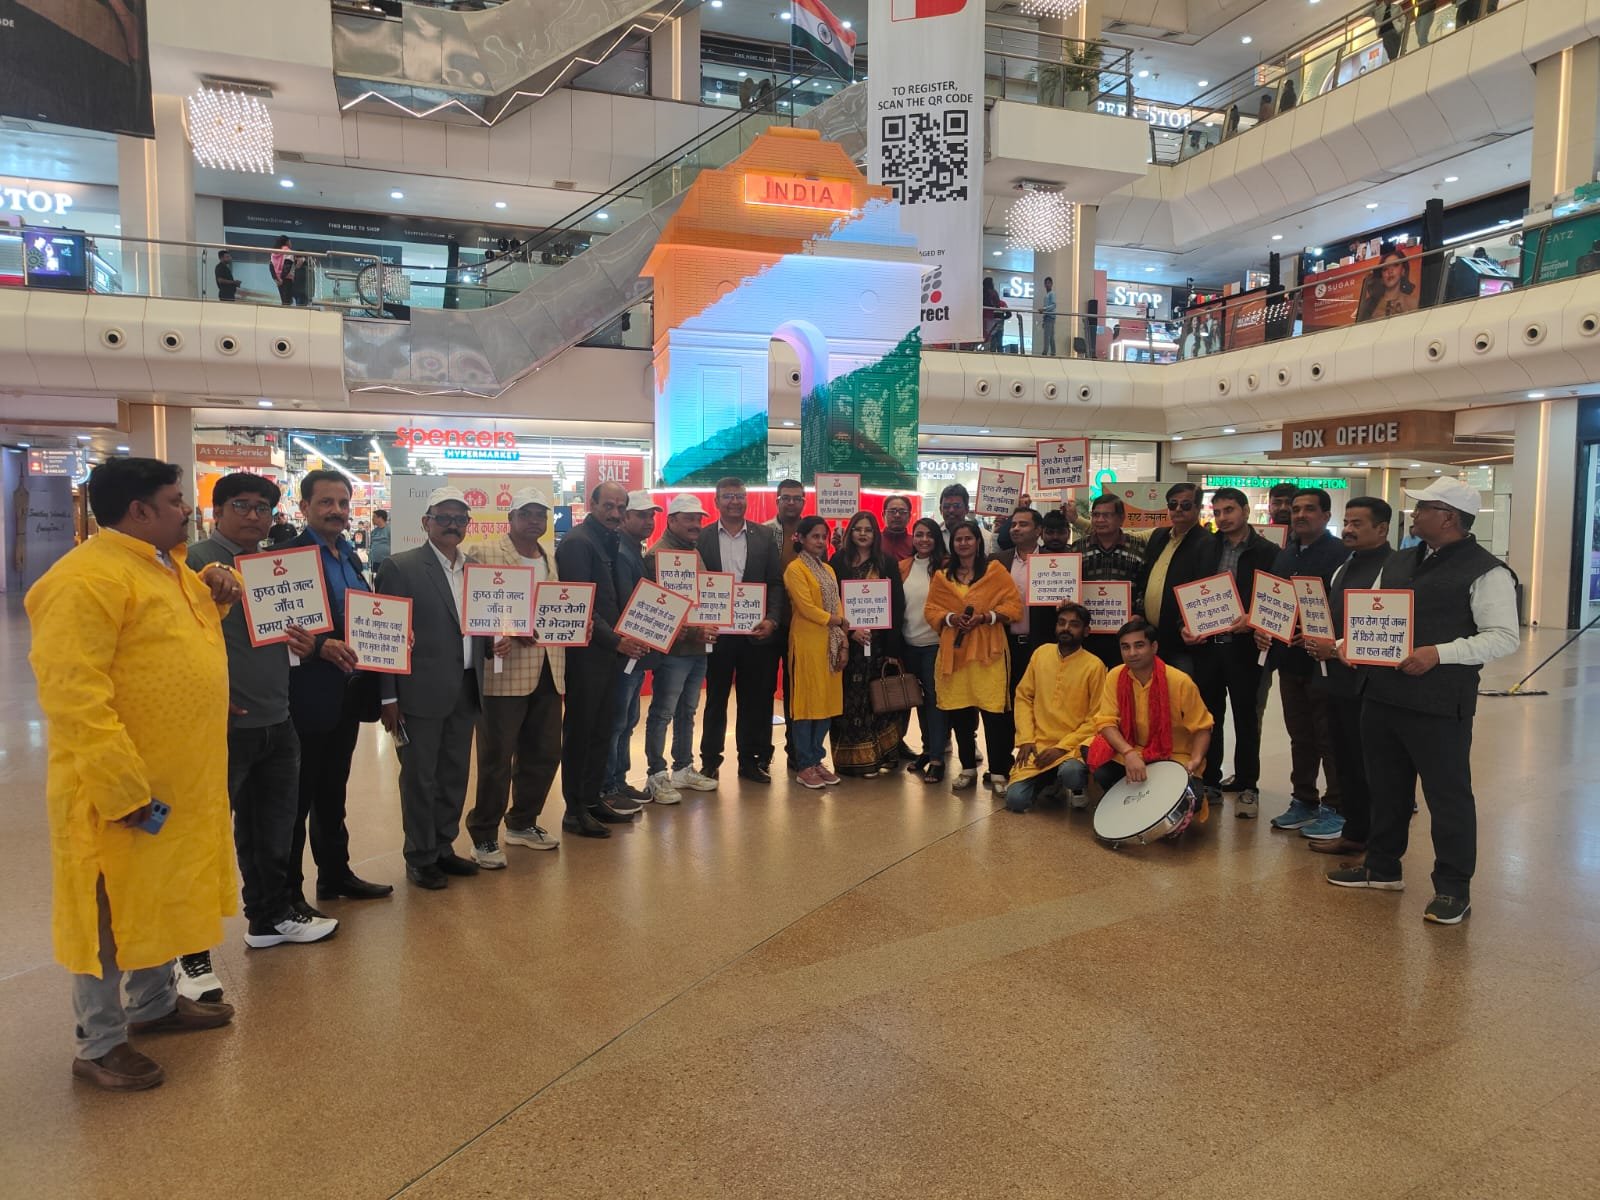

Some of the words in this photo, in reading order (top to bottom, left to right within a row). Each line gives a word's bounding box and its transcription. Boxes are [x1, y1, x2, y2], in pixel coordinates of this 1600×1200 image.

[892, 87, 905, 96] TO
[908, 81, 958, 94] REGISTER,
[878, 100, 904, 110] SCAN
[906, 97, 925, 107] THE
[928, 96, 942, 106] QR
[945, 93, 973, 103] CODE
[766, 180, 834, 204] INDIA
[1327, 280, 1355, 292] SUGAR
[392, 427, 516, 452] spencers
[1292, 429, 1325, 449] BOX
[1336, 422, 1398, 446] OFFICE
[200, 447, 210, 455] At
[213, 447, 234, 456] Your
[239, 449, 269, 457] Service
[447, 449, 518, 460] HYPERMARKET
[920, 462, 948, 471] POLO
[598, 465, 630, 482] SALE
[252, 586, 275, 602] कुष्ठ
[276, 580, 291, 594] की
[293, 580, 314, 591] जल्द
[472, 590, 491, 601] कुष्ठ
[493, 588, 504, 600] की
[506, 591, 524, 600] जल्द
[274, 597, 295, 612] जाँच
[296, 599, 304, 608] व
[487, 603, 504, 614] जाँच
[506, 605, 512, 614] व
[539, 604, 561, 616] कुष्ठ
[563, 602, 586, 614] रोगी
[256, 620, 282, 634] समय
[284, 616, 294, 626] से
[296, 612, 323, 628] इलाज
[469, 619, 490, 628] समय
[493, 617, 500, 627] से
[536, 617, 545, 628] से
[549, 618, 585, 628] भेदभाव
[1350, 616, 1364, 628] कुष्ठ
[1366, 615, 1378, 626] रोग
[1379, 615, 1390, 630] पूर्व
[1392, 618, 1407, 627] जन्म
[544, 632, 553, 641] न
[557, 630, 575, 641] करें
[1360, 630, 1374, 641] किये
[1376, 631, 1387, 642] गये
[1390, 632, 1405, 643] पापों
[1356, 647, 1365, 656] का
[1367, 647, 1380, 656] फल
[1382, 645, 1395, 657] नहीं
[1396, 647, 1401, 658] है
